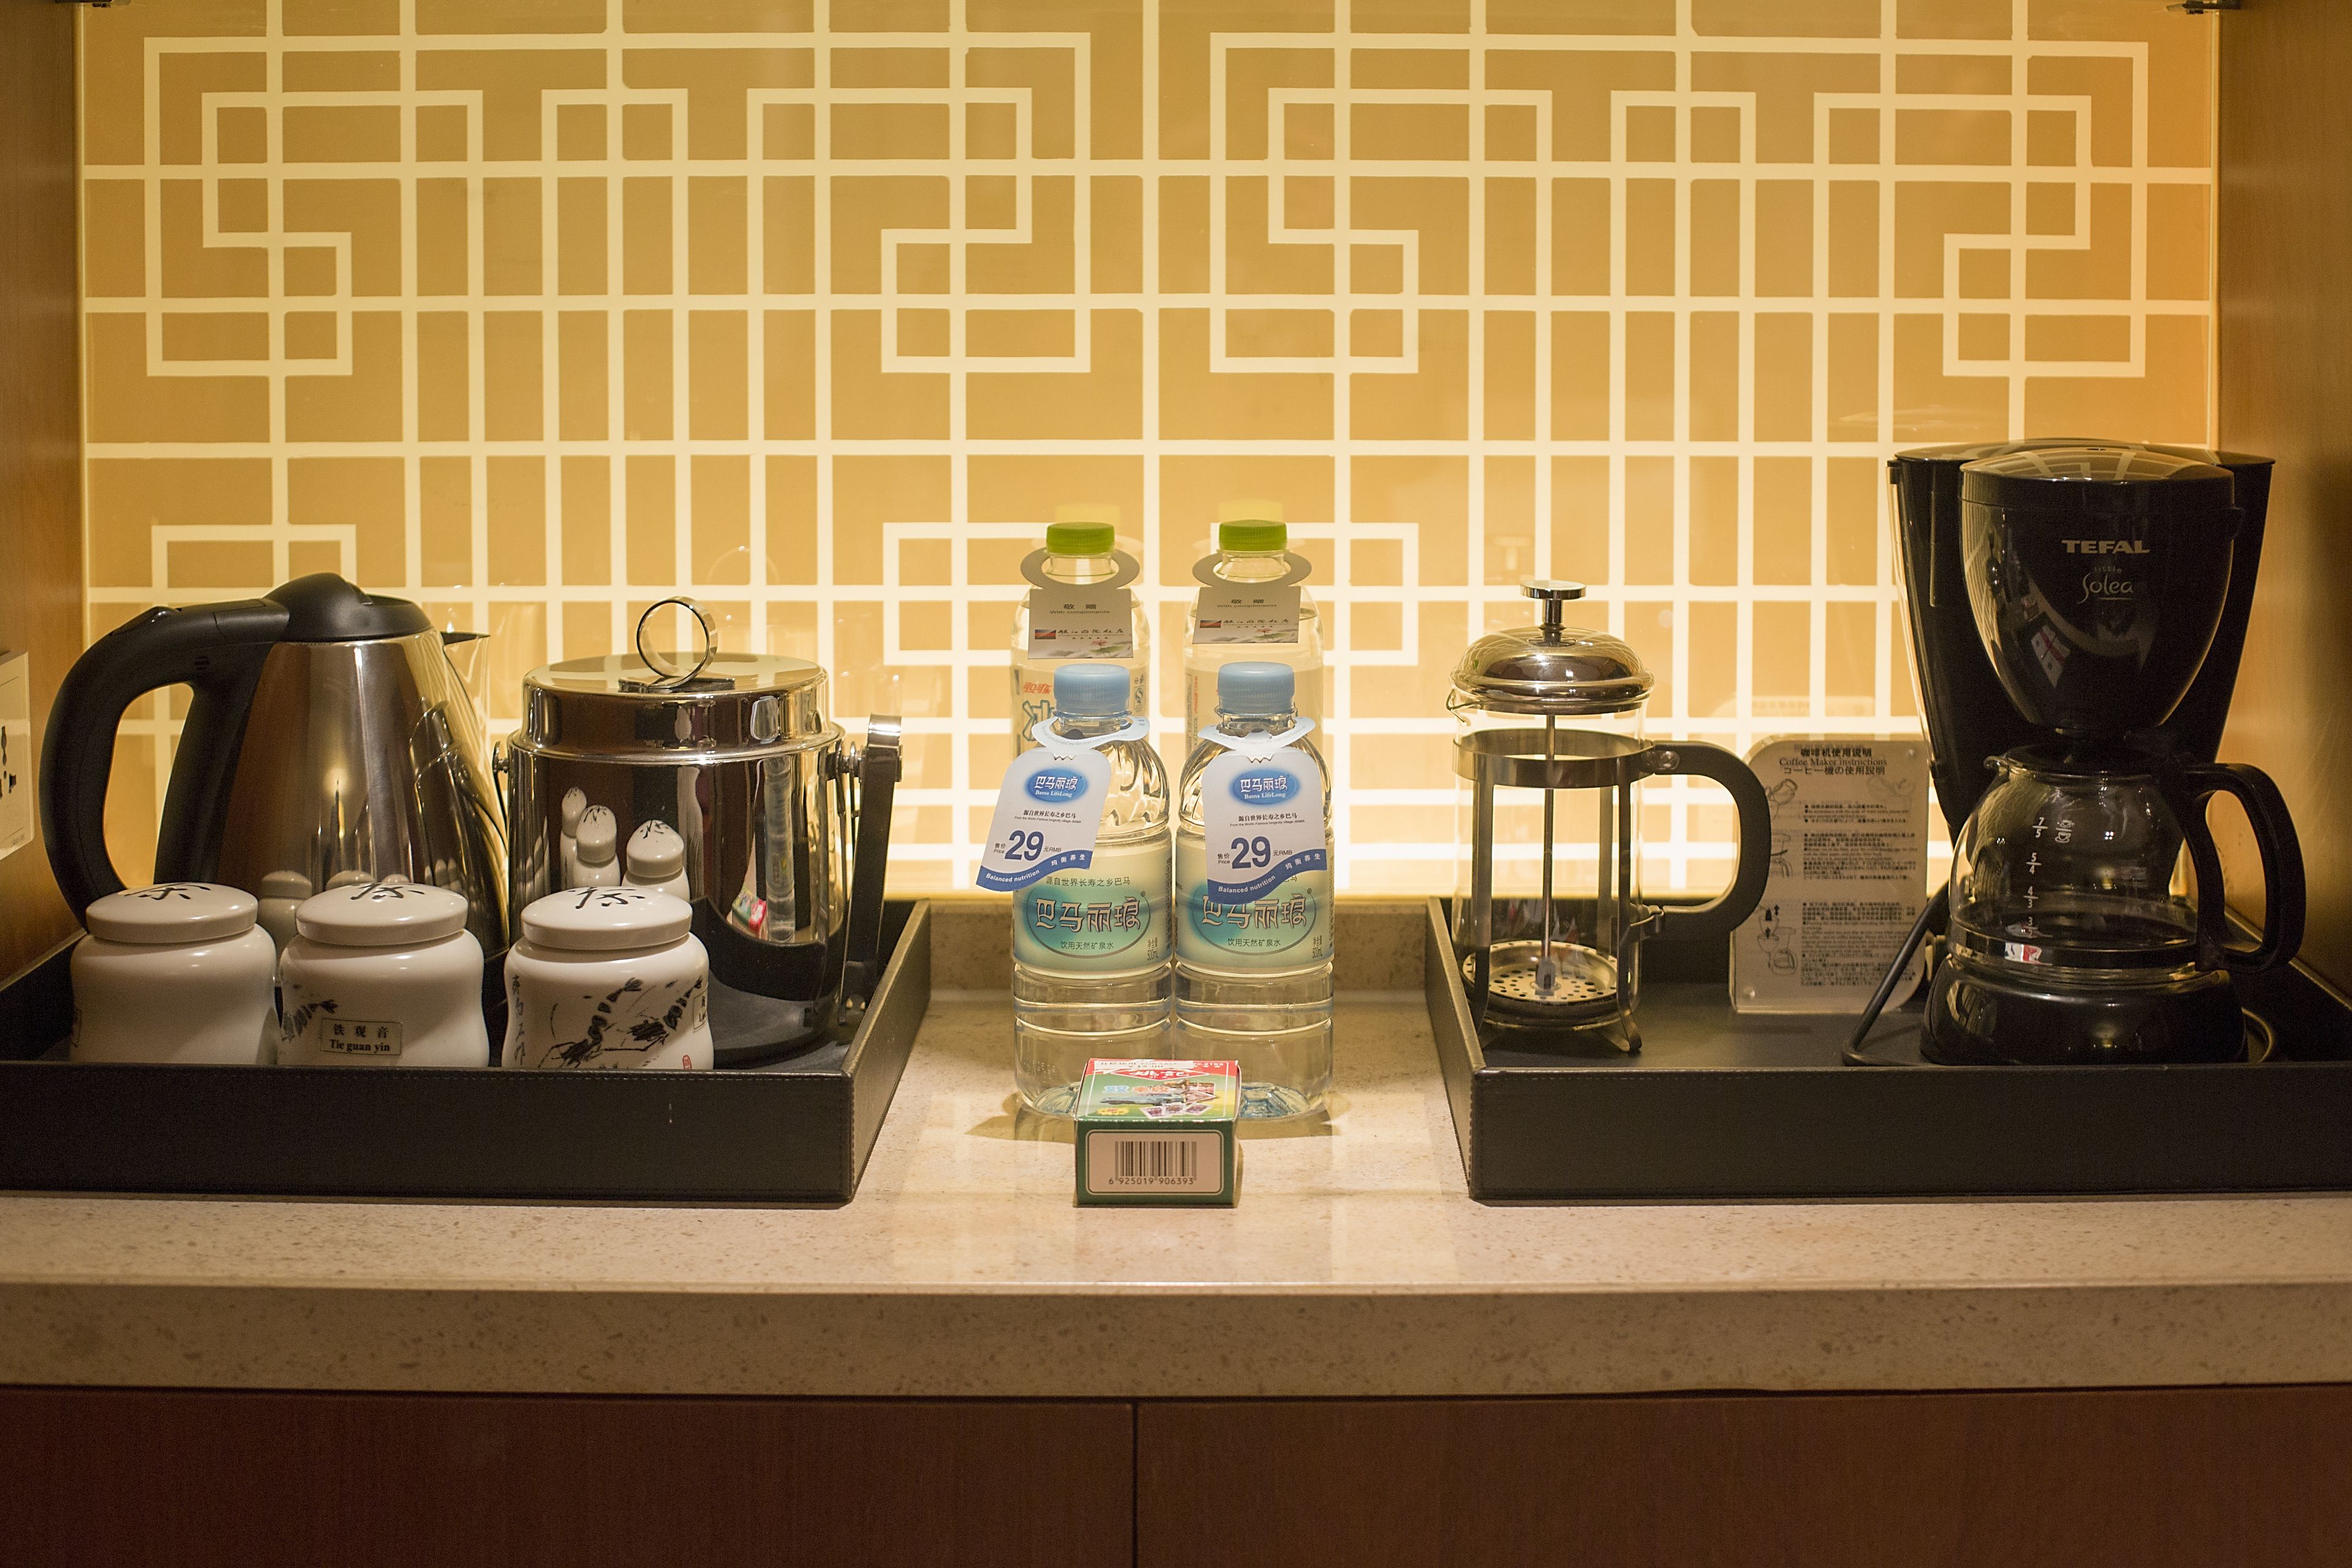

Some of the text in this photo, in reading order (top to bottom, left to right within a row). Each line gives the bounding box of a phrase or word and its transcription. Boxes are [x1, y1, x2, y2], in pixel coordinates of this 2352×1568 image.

[2061, 540, 2150, 554] TEFAL
[2077, 573, 2133, 604] Solea
[1779, 757, 1807, 766] Coffee
[1023, 809, 1076, 819] 源自世界长寿之乡巴马
[1238, 812, 1297, 822] 源自世界长寿之乡巴马
[2039, 817, 2045, 826] 7
[2035, 829, 2041, 838] 5
[1005, 830, 1044, 861] 29
[1231, 836, 1271, 869] 29
[2031, 853, 2037, 862] 5
[1051, 853, 1086, 866] 均衡养生
[1285, 853, 1321, 870] 均衡养生
[2029, 865, 2035, 875] 4
[986, 869, 1040, 883] Balanced nutrition
[1046, 876, 1131, 887] 源自世界长寿之乡巴马
[1250, 875, 1276, 891] nutrition
[2027, 886, 2034, 895] 4
[2027, 899, 2033, 908] 3
[2028, 917, 2033, 926] 3
[1060, 941, 1114, 950] 饮用天然矿泉水
[1227, 938, 1281, 947] 饮用天然矿泉水
[333, 1023, 388, 1038] 铁观音
[330, 1039, 390, 1054] Tie guan yin
